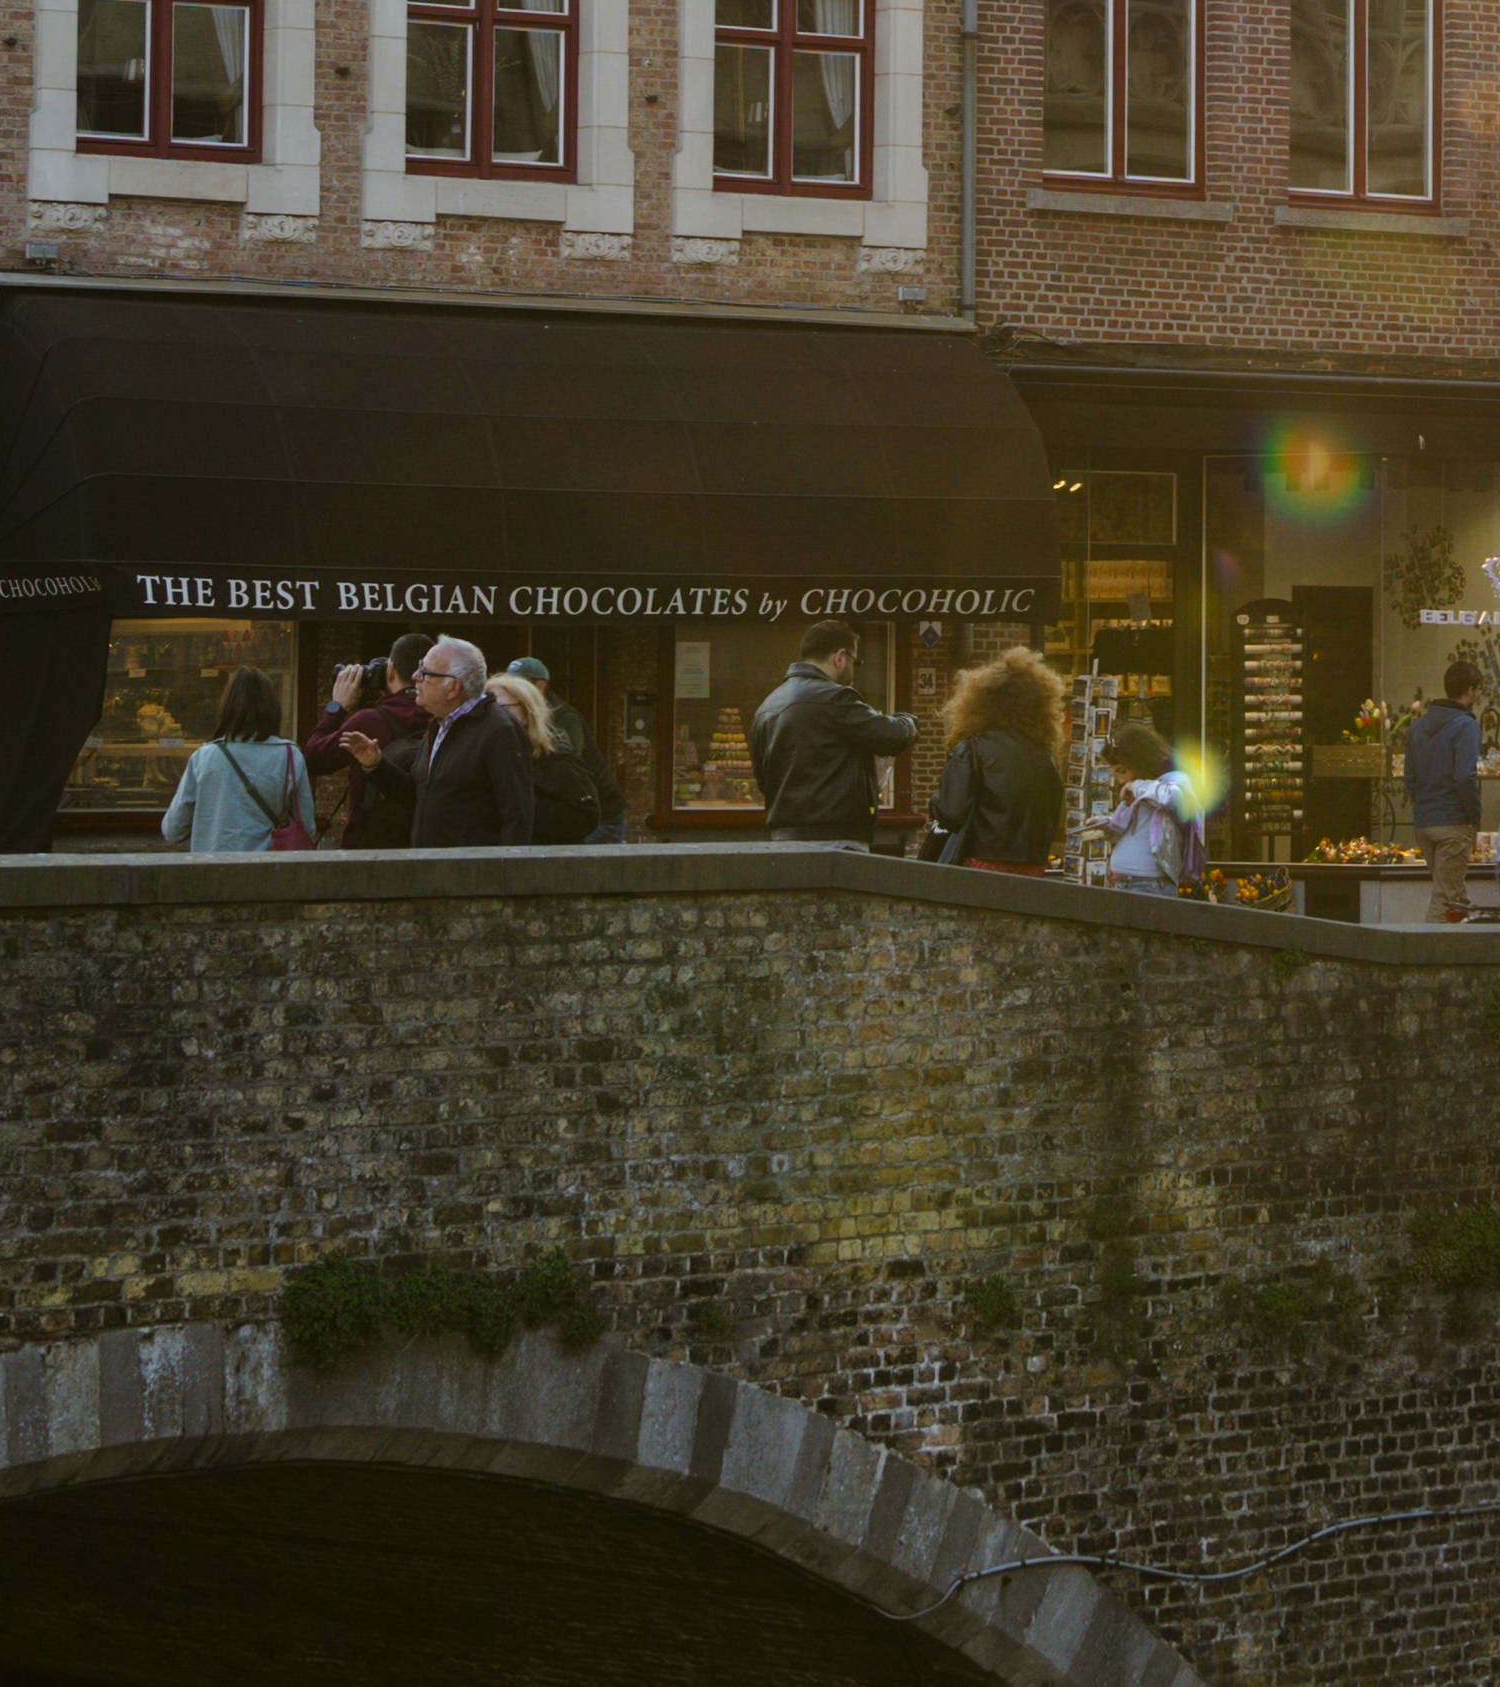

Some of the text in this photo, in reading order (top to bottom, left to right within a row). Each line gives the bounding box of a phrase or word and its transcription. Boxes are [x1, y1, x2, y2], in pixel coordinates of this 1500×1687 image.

[136, 574, 1035, 622] THE BEST BELGIAN CHOCOLATES by CHOCOHOLIC
[918, 673, 934, 689] 34
